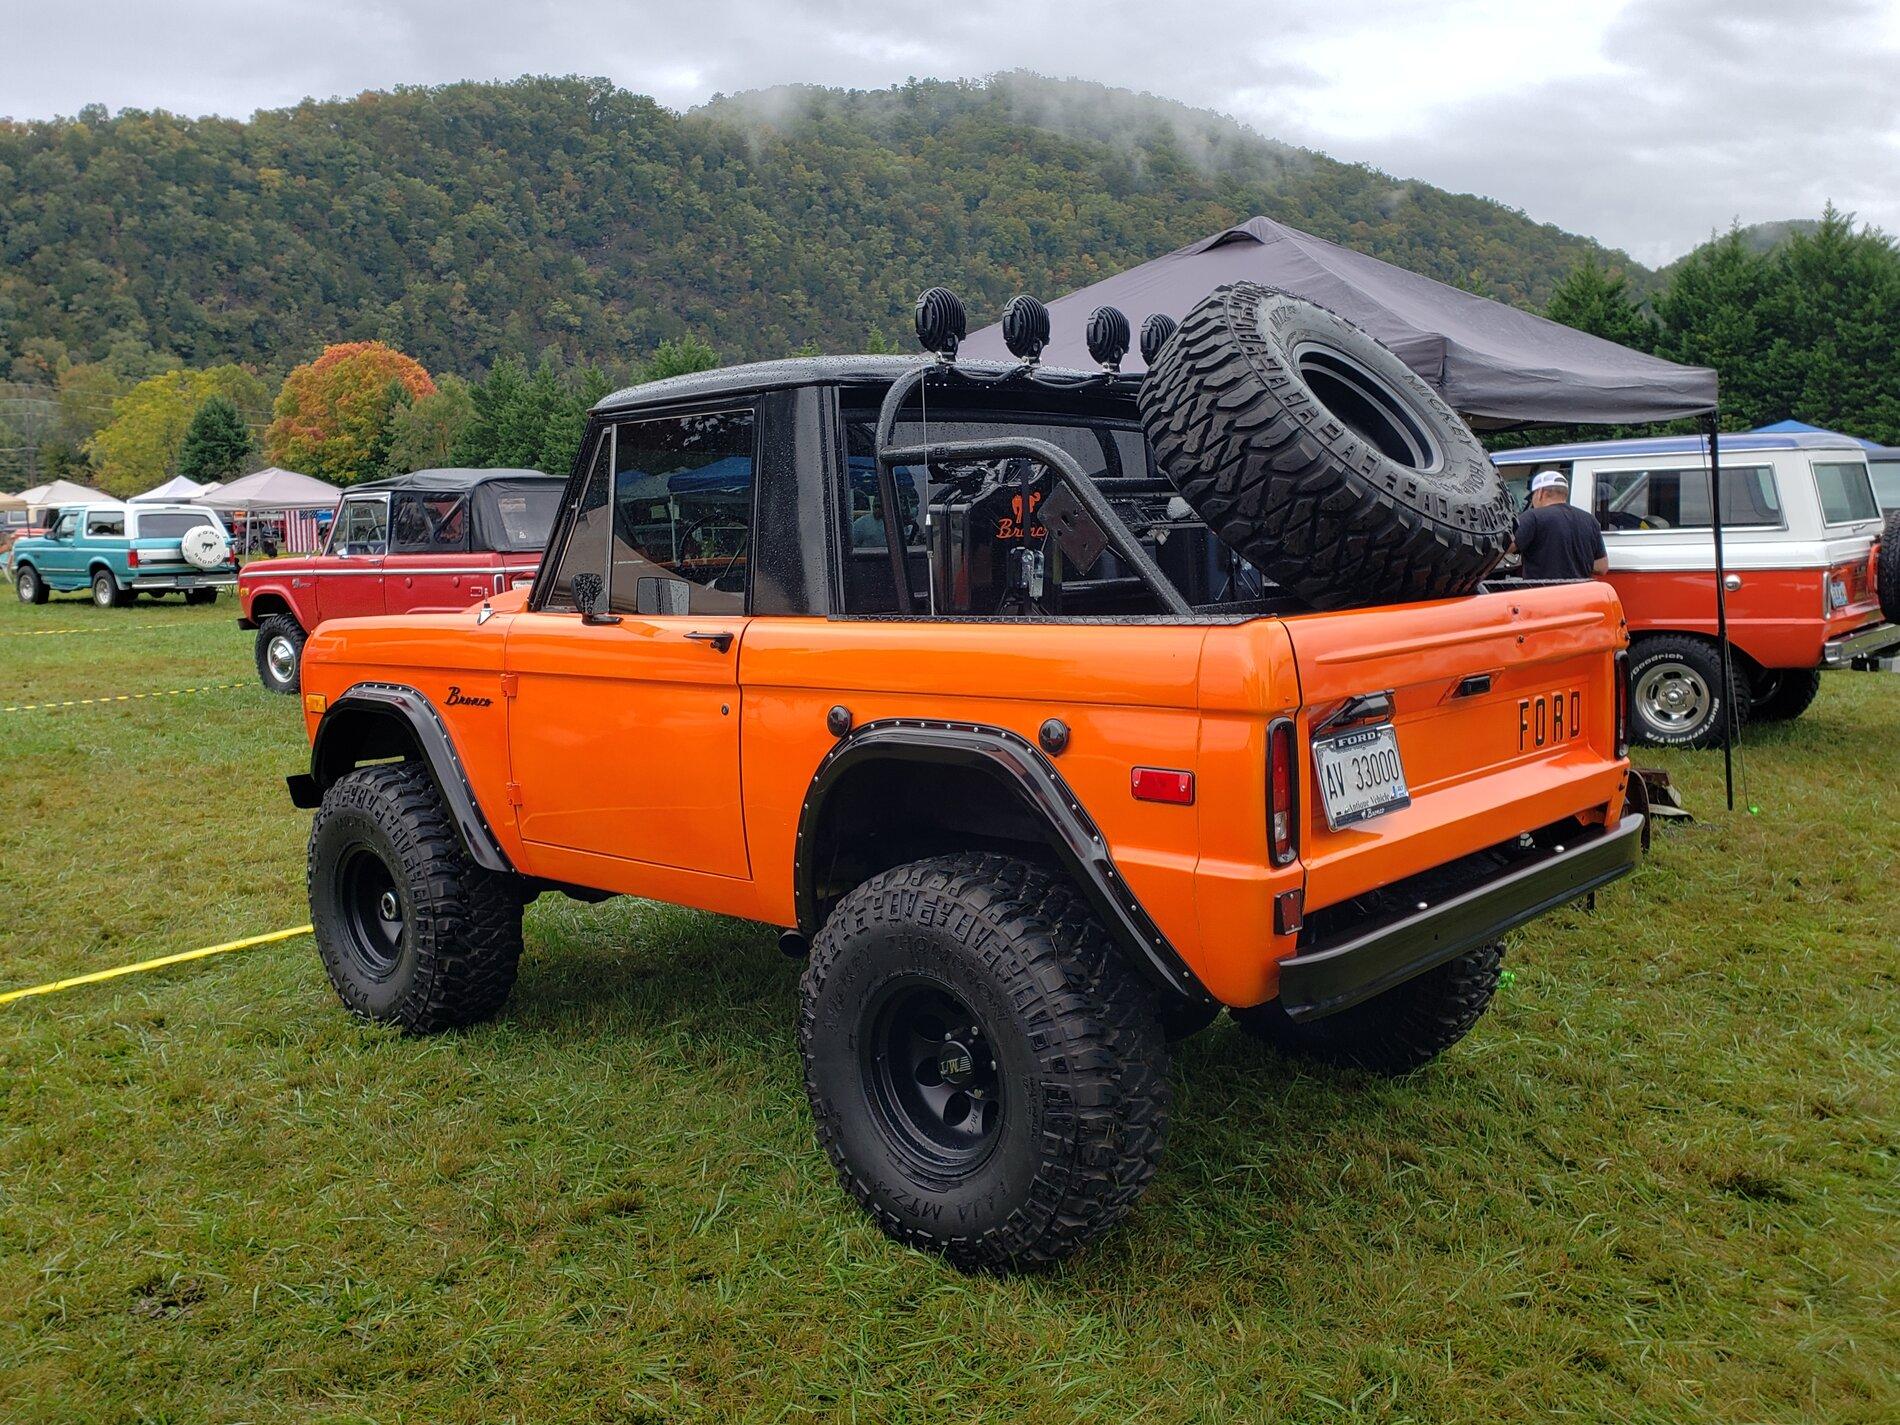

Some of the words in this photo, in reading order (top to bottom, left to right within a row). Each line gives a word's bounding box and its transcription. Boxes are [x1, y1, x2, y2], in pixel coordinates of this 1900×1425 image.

[1402, 374, 1480, 454] MICKEY
[197, 530, 220, 539] FORD
[995, 518, 1049, 539] Brnc
[194, 552, 221, 565] BRONCO
[1630, 652, 1684, 680] Goodrich
[443, 685, 494, 707] Bronco
[1518, 690, 1581, 751] FORD
[1337, 731, 1376, 747] FORD
[1325, 761, 1346, 800] AV
[1351, 748, 1400, 791] 33000
[891, 1186, 945, 1224] MTZ
